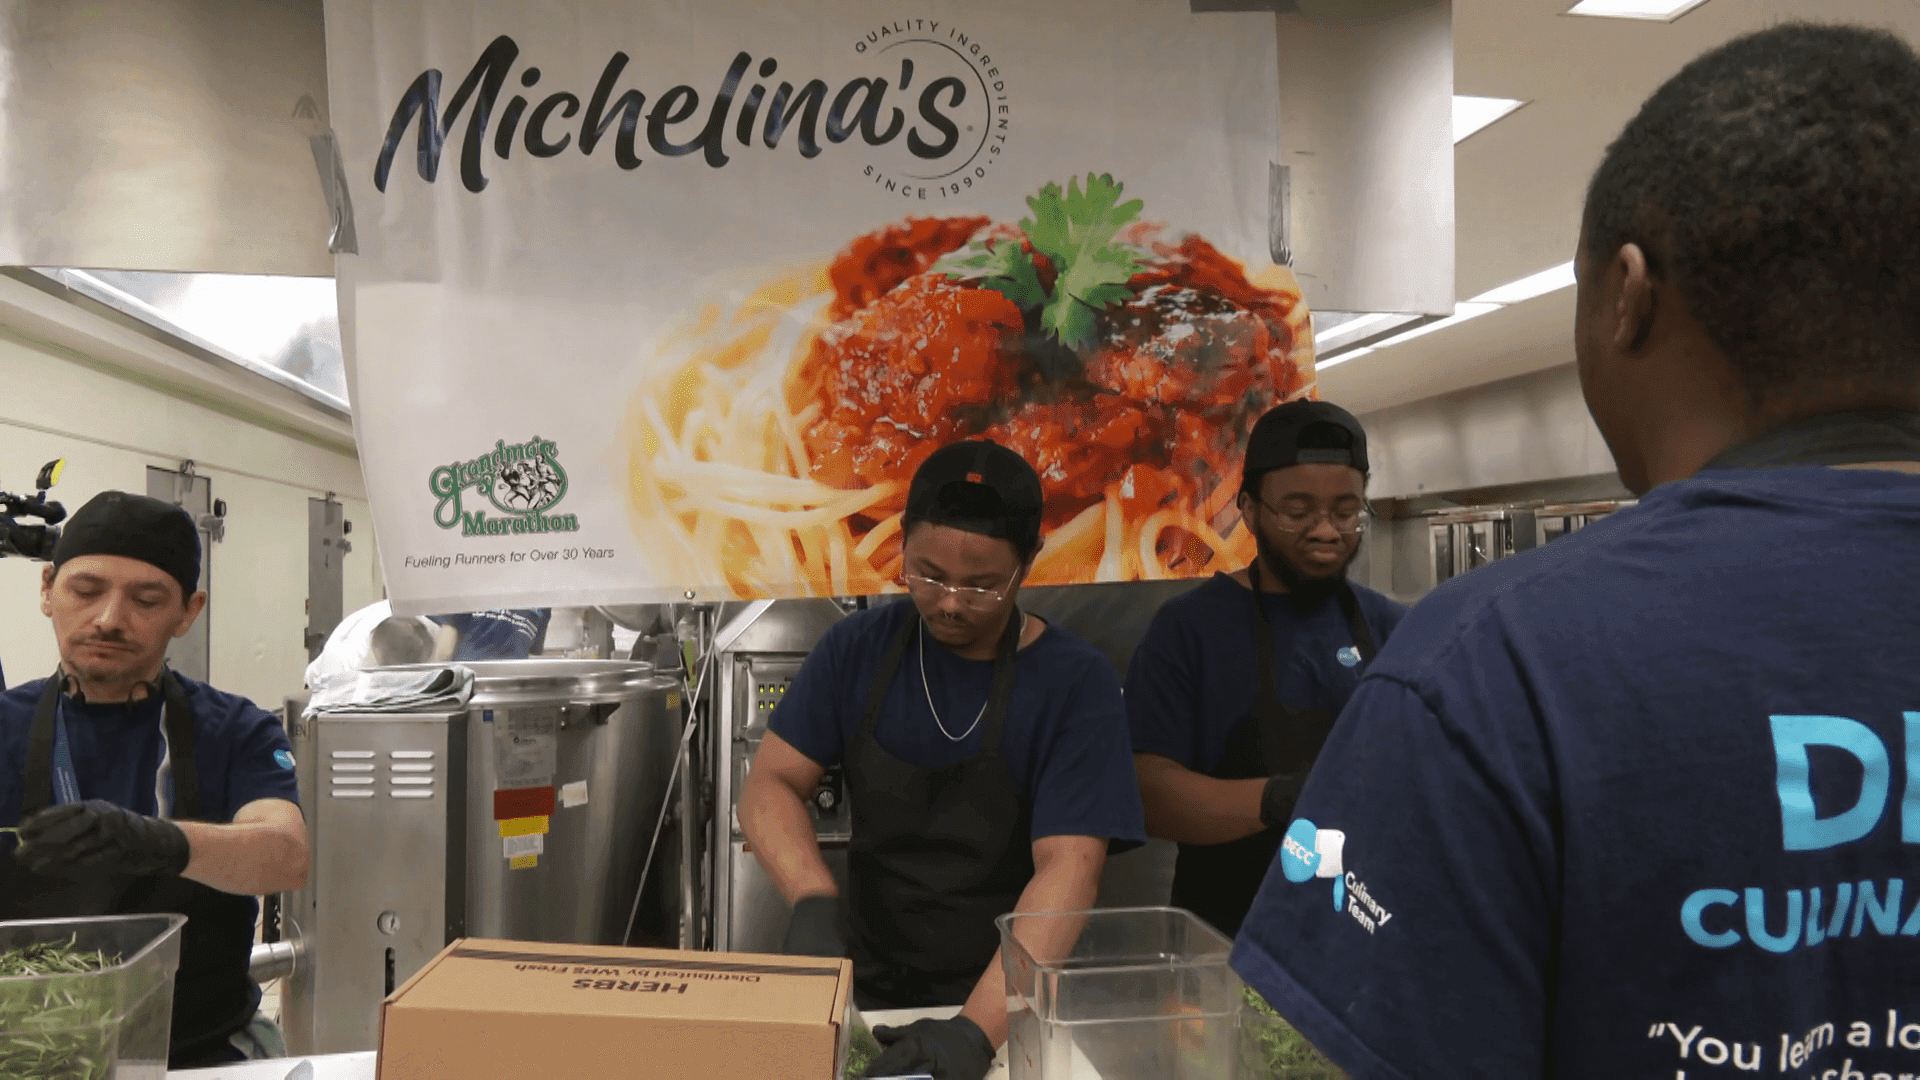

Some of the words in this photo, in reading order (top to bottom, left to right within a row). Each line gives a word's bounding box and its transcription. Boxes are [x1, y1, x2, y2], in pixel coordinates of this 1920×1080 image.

[855, 19, 940, 54] QUALITY
[373, 34, 967, 194] Michelina's
[863, 164, 926, 200] SINCE
[940, 166, 985, 198] 1990
[462, 510, 579, 537] Marathon
[404, 555, 451, 568] Fueling
[455, 553, 506, 566] Runners
[510, 550, 527, 562] for
[530, 549, 560, 562] Over
[563, 548, 579, 560] 30
[582, 547, 615, 559] Years
[1283, 836, 1314, 865] DECC
[1345, 871, 1392, 926] Culinary
[1348, 894, 1375, 934] Team
[514, 963, 568, 975] Fresh
[627, 969, 649, 978] by
[654, 970, 761, 983] Distributed
[572, 978, 689, 994] HERBS
[1780, 1022, 1834, 1072] learn
[1847, 1021, 1871, 1047] a
